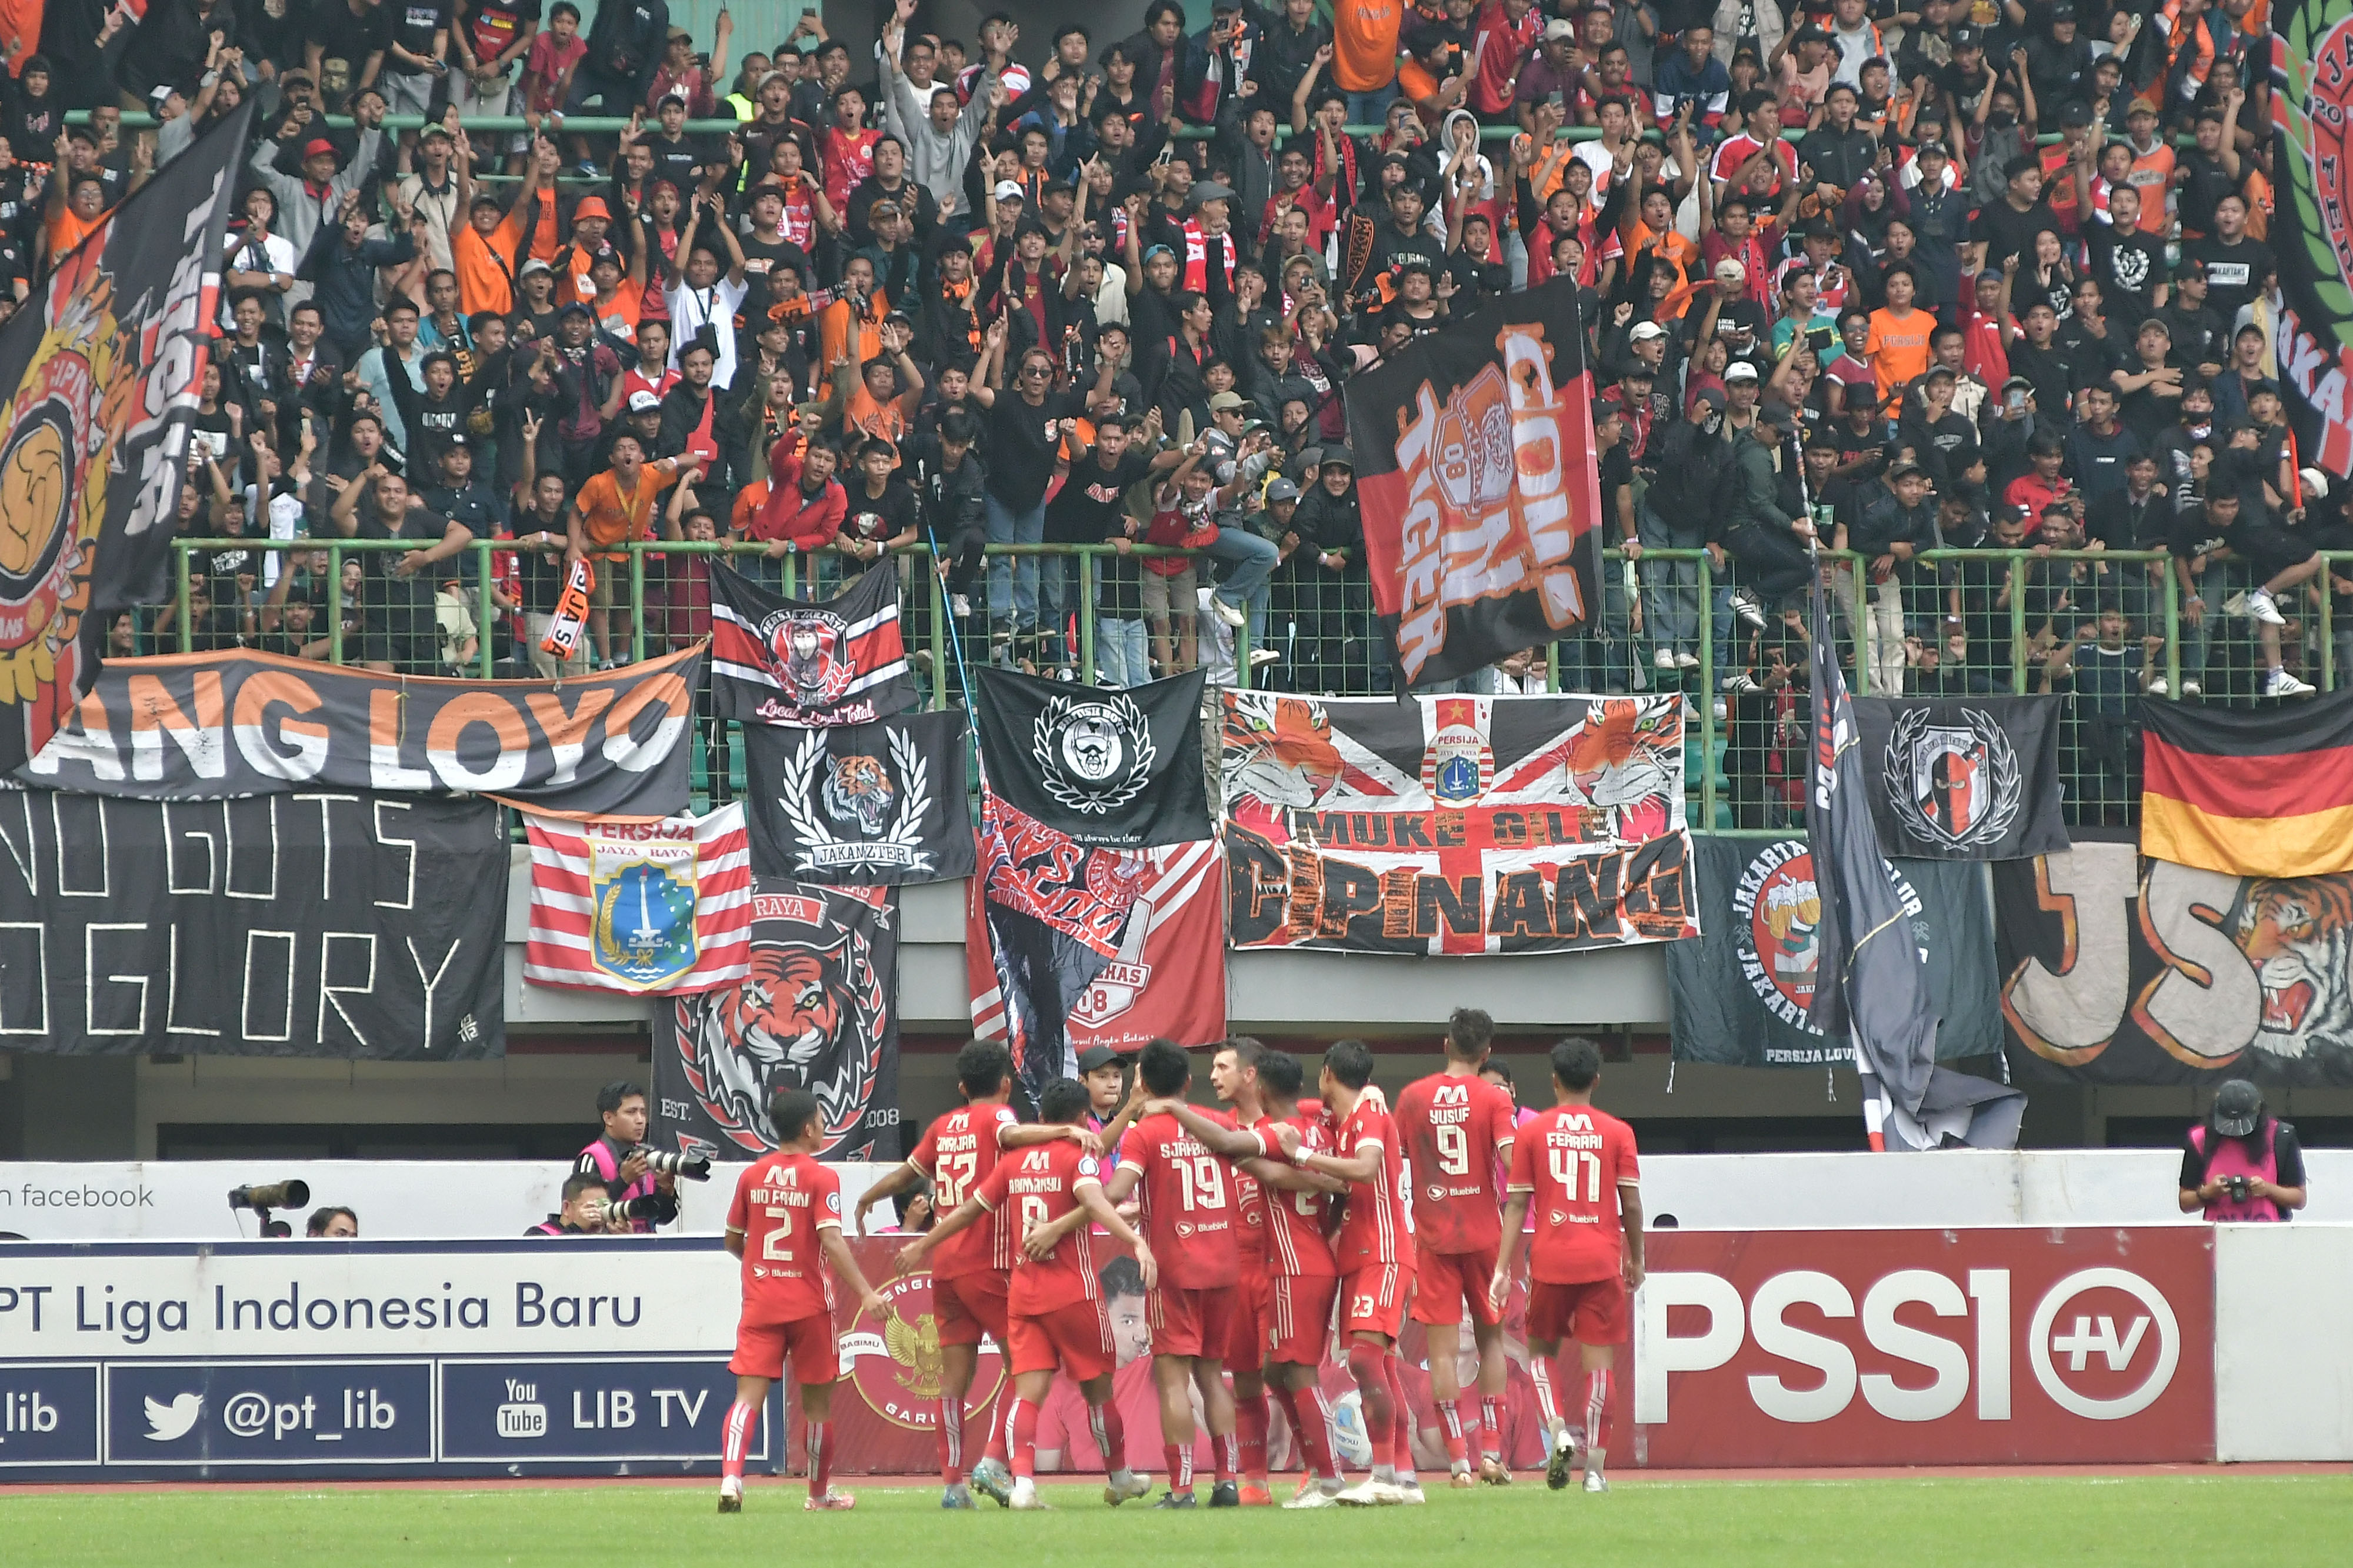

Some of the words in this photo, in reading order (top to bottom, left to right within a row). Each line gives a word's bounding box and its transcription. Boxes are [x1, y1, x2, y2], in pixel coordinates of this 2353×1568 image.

[1396, 380, 1448, 684] TIGER
[755, 696, 802, 719] Local
[840, 698, 876, 725] Total
[1056, 707, 1100, 733] BRITISH
[369, 672, 690, 792] LOYO
[1438, 735, 1479, 745] PERSIJA
[583, 823, 694, 842] PERSIJA
[1084, 833, 1110, 843] always
[1122, 833, 1143, 843] there
[1293, 810, 1467, 848] MUKE
[162, 793, 417, 910] GUTS
[596, 845, 638, 856] JAYA
[1224, 819, 1691, 945] CIPINANG
[1732, 840, 1809, 919] JAKARTA
[755, 898, 806, 918] RAYA
[85, 922, 461, 1049] GLORY
[1076, 989, 1108, 1013] 08
[1766, 1047, 1823, 1063] PERSIJA
[660, 1097, 692, 1122] EST.
[1429, 1106, 1471, 1125] YUSUF
[1436, 1125, 1469, 1175] 9
[1546, 1132, 1603, 1150] FERRARI
[1008, 1177, 1062, 1195] ABIMANYU
[1171, 1156, 1227, 1212] 19
[1548, 1149, 1601, 1203] 41
[22, 1183, 155, 1207] facebook
[750, 1189, 769, 1205] RIO
[1450, 1185, 1481, 1196] Bluebird
[1198, 1220, 1228, 1233] Bluebird
[1569, 1213, 1599, 1224] Bluebird
[762, 1207, 793, 1262] 2
[771, 1269, 802, 1278] Bluebird
[76, 1284, 188, 1345] Liga
[215, 1281, 488, 1332] Indonesia
[515, 1282, 641, 1329] Baru
[1351, 1296, 1375, 1318] 23
[1634, 1267, 2012, 1424] PSSI
[505, 1379, 536, 1402] You
[0, 1392, 58, 1443] lib
[223, 1389, 396, 1441] @pt_lib
[501, 1409, 542, 1432] Tube
[572, 1390, 636, 1429] LIB
[650, 1390, 709, 1429] TV
